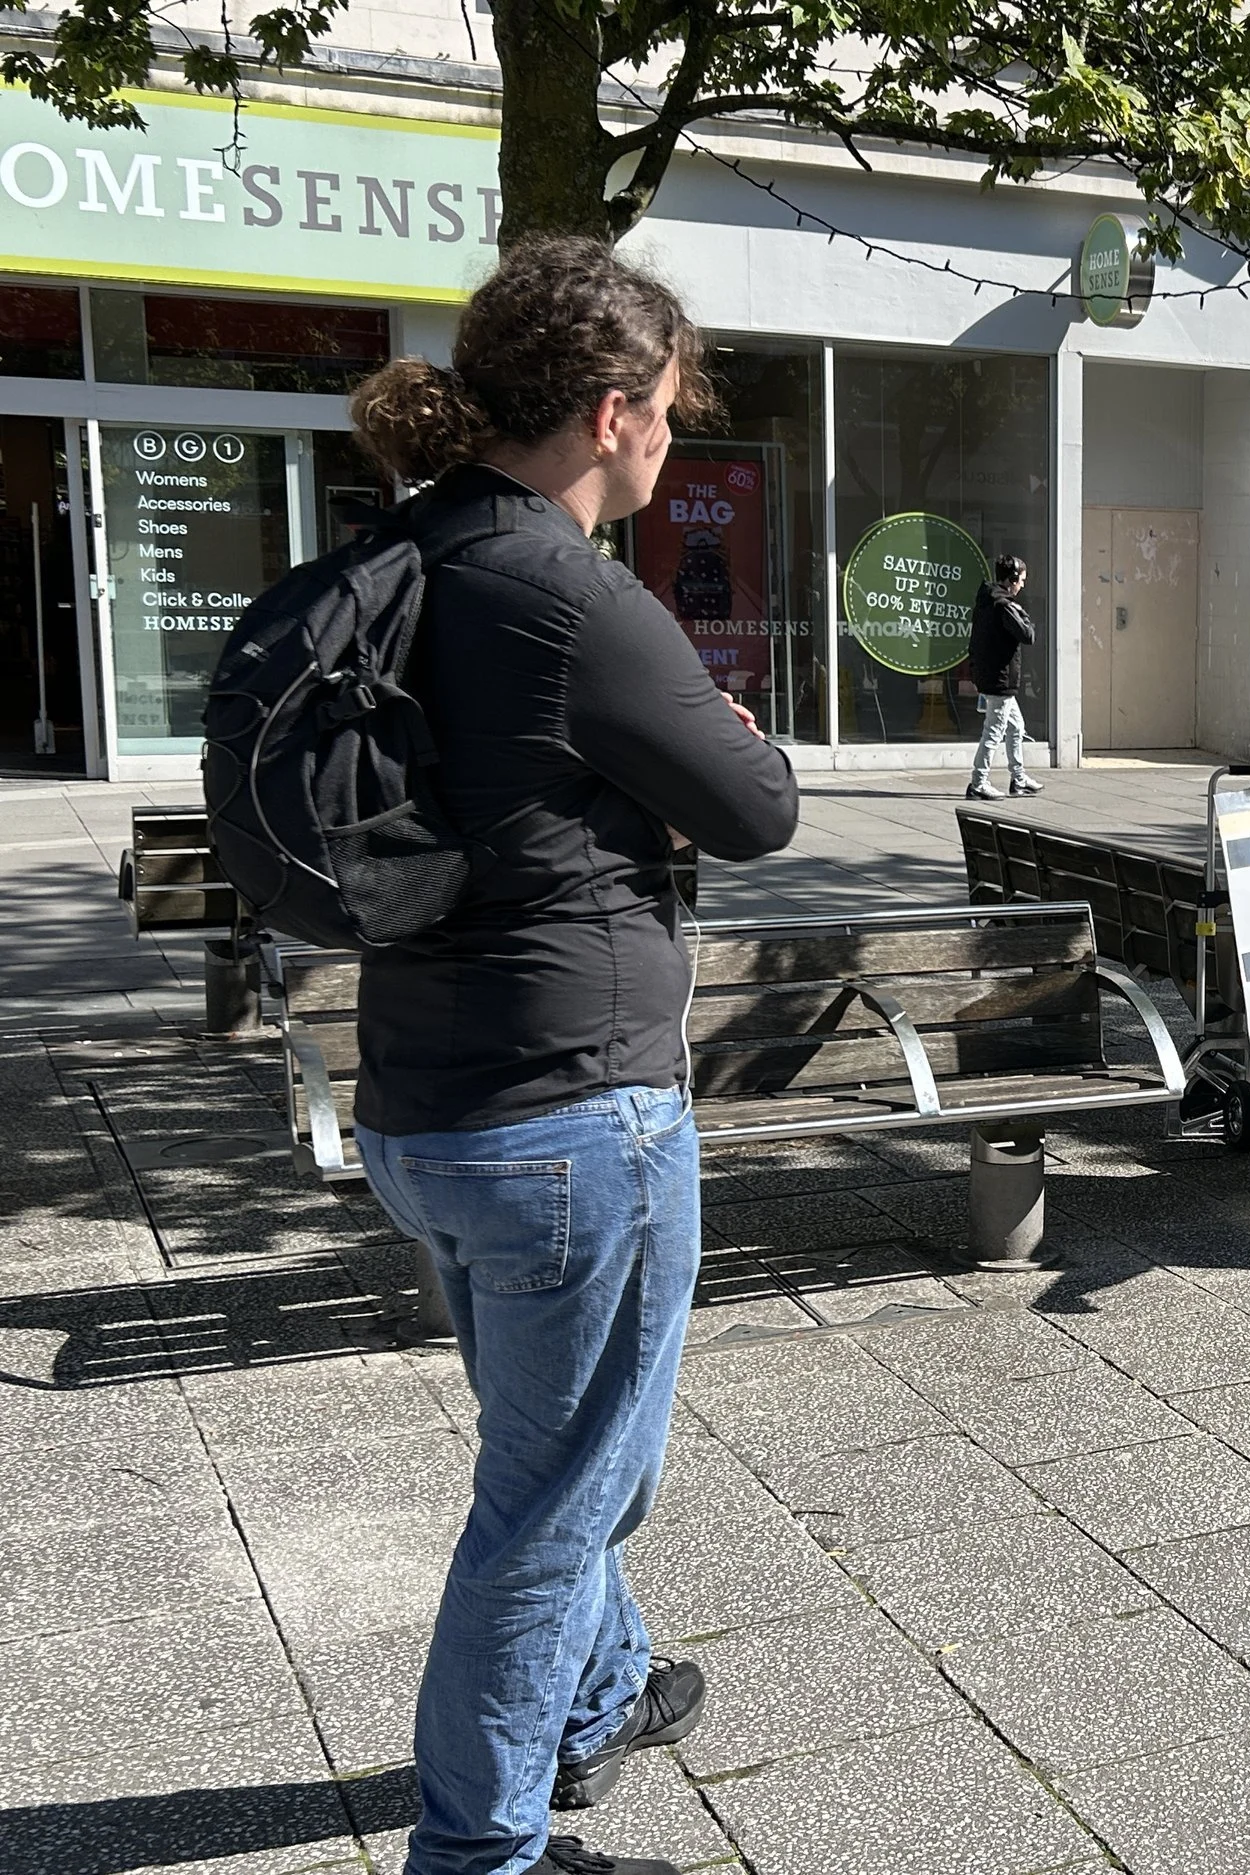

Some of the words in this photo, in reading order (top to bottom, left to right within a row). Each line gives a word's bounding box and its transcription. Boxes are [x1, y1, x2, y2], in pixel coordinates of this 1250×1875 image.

[1089, 249, 1120, 270] HOME
[1089, 270, 1120, 291] SENSE
[143, 438, 156, 453] B
[181, 440, 198, 454] G
[135, 470, 208, 488] Womens
[727, 468, 755, 490] 60%
[686, 484, 717, 498] THE
[137, 495, 231, 513] Accessories
[669, 499, 735, 525] BAG
[138, 519, 188, 535] Shoes
[139, 543, 183, 559] Mens
[140, 567, 176, 583] Kids
[883, 555, 962, 581] SAVINGS
[895, 577, 920, 593] UP
[924, 581, 948, 598] TO
[142, 591, 187, 607] Click
[191, 592, 203, 607] &
[207, 592, 255, 608] Colle
[866, 592, 904, 611] 60%
[909, 598, 972, 621] EVERY
[143, 615, 240, 631] HOMESE
[694, 620, 814, 636] HOMESENS
[698, 649, 739, 665] ENT
